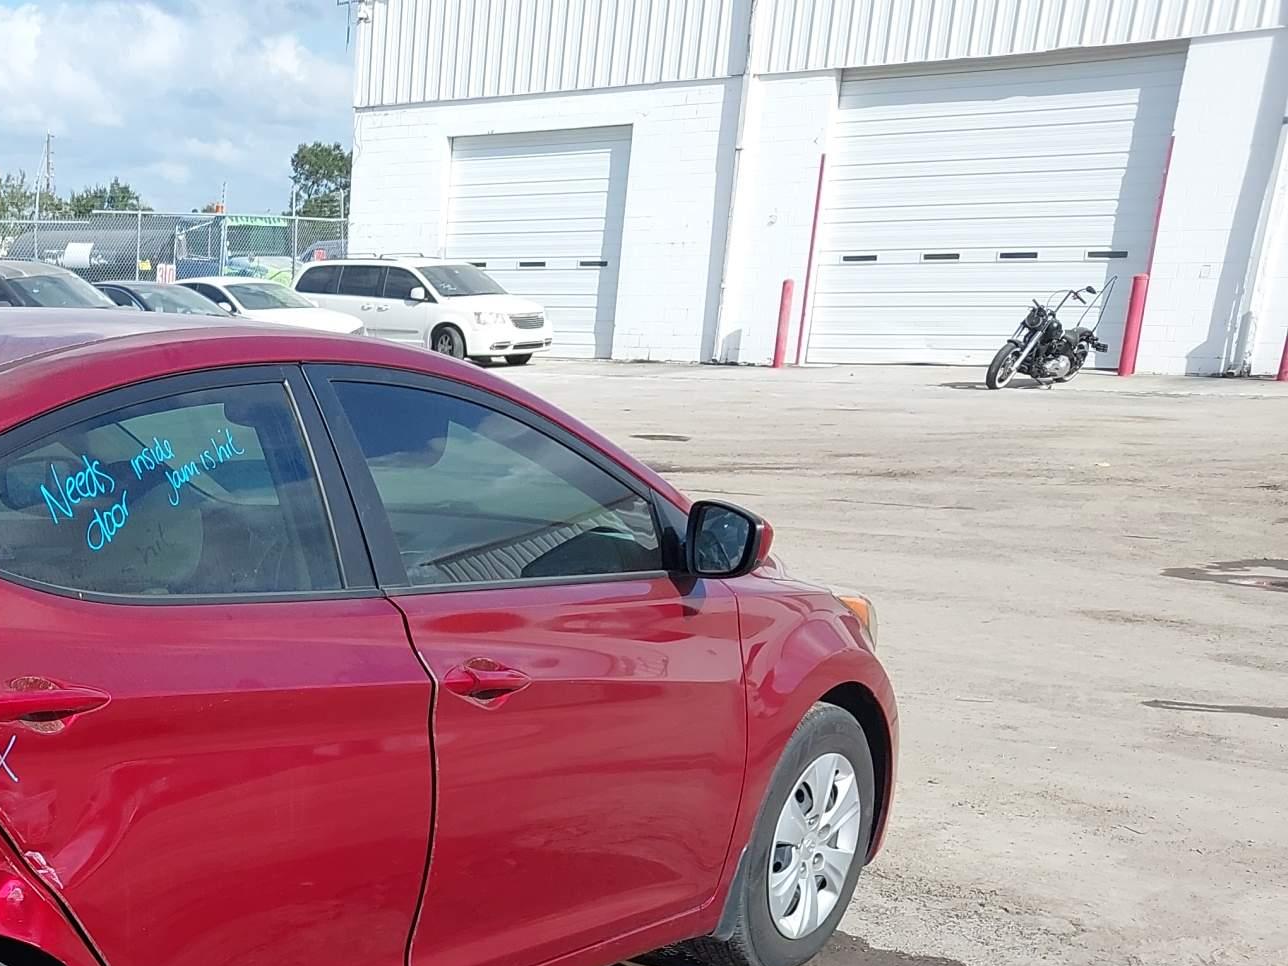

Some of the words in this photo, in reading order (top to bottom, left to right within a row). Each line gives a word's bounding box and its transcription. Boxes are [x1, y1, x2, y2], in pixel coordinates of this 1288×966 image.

[40, 456, 115, 524] Needs
[130, 437, 175, 479] inside
[87, 490, 131, 550] door
[211, 428, 244, 463] hit
